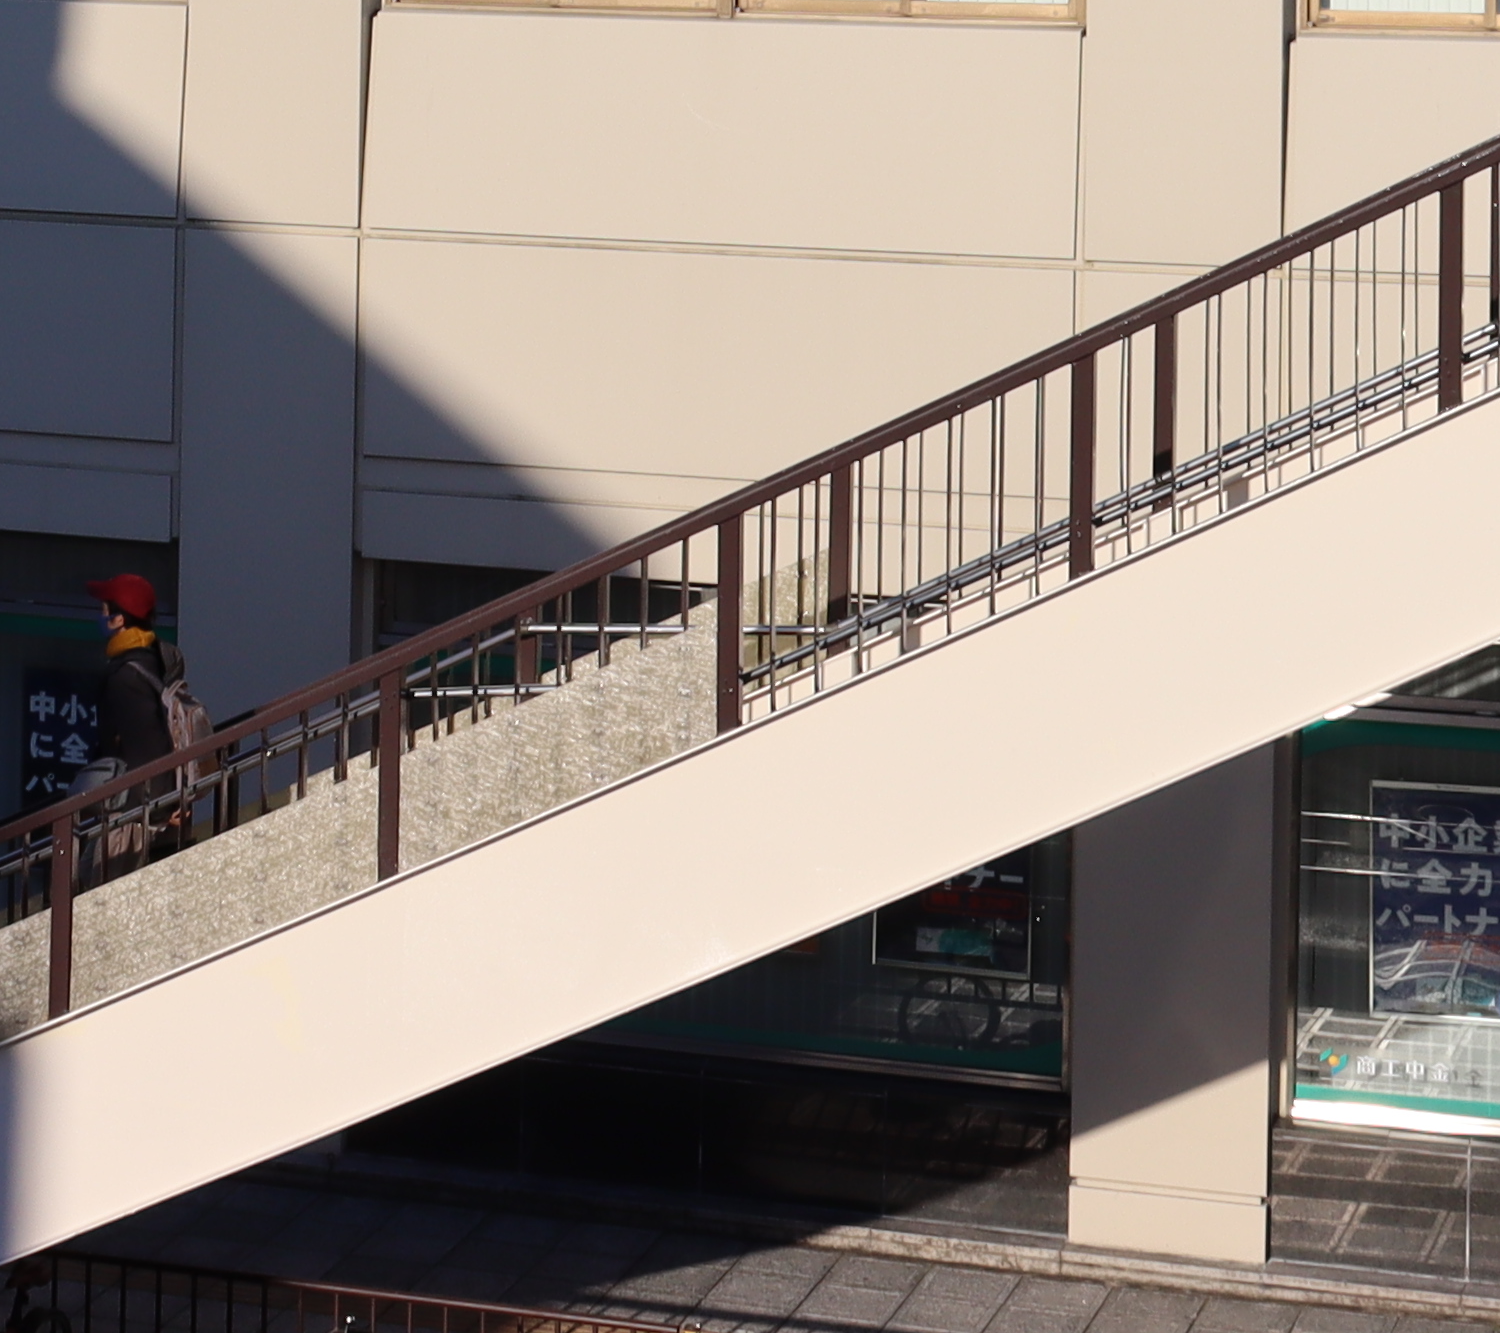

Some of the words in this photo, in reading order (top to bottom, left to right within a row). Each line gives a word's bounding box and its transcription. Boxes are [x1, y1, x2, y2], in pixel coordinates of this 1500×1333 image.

[1380, 857, 1494, 898] に全力
[1356, 1054, 1450, 1084] 商工中金
